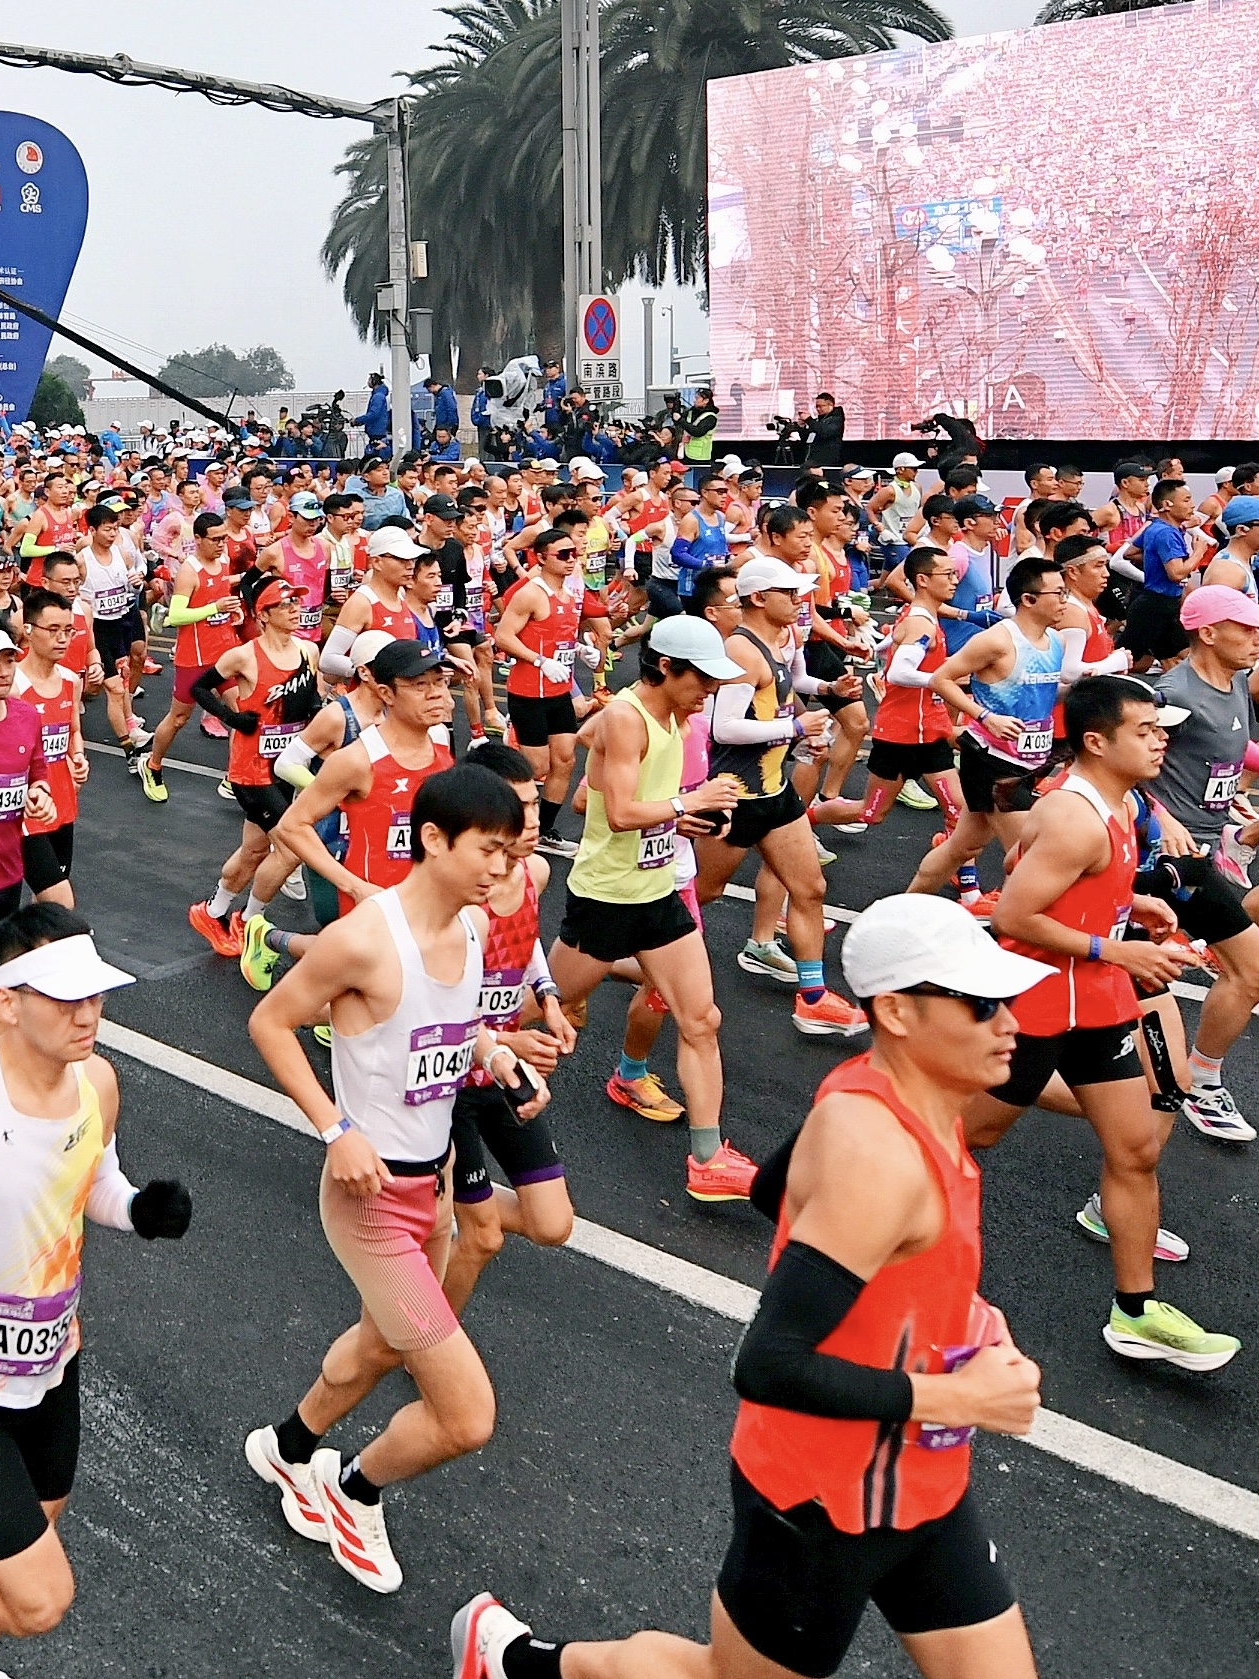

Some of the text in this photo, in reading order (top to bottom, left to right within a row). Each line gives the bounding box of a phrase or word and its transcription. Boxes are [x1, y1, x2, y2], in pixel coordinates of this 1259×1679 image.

[20, 203, 42, 213] CMS
[583, 362, 617, 379] 南滨路
